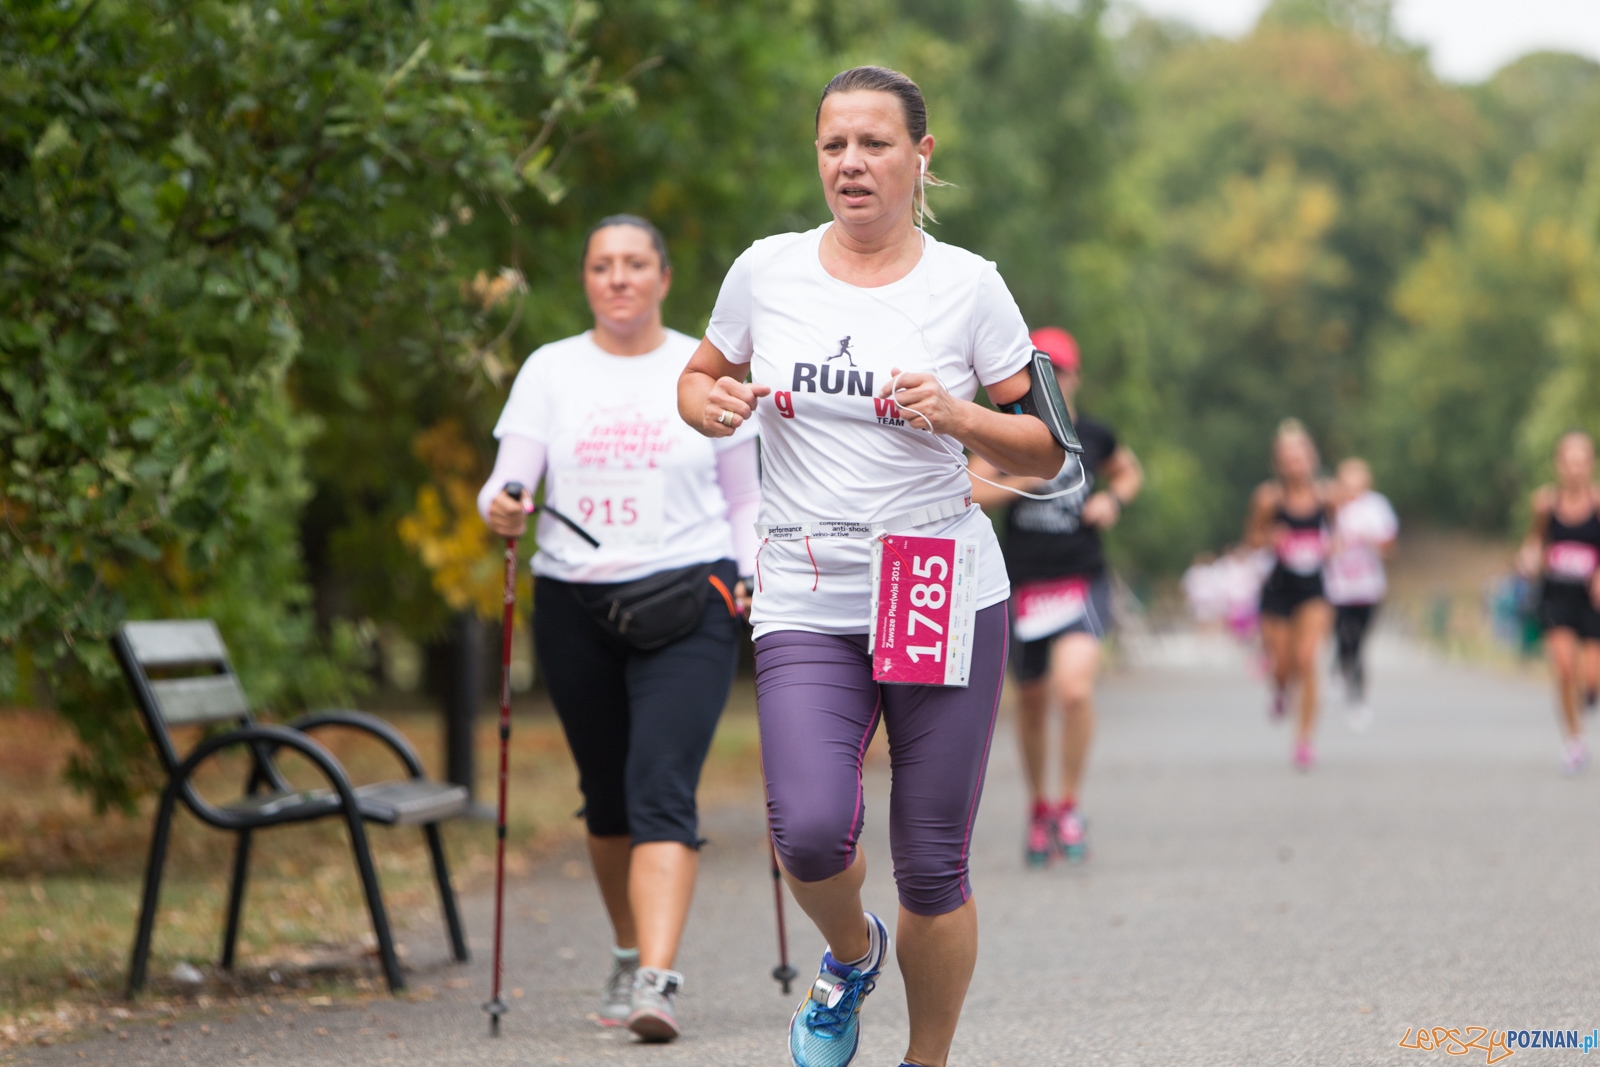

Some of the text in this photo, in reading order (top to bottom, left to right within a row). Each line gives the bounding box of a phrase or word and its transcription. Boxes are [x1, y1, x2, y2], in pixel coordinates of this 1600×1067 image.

[792, 362, 874, 397] RUN
[774, 390, 795, 419] g
[877, 416, 905, 427] TEAM
[577, 496, 639, 526] 915
[768, 525, 802, 534] performance
[891, 560, 901, 582] 2016
[888, 584, 899, 618] Pier(w)si
[906, 555, 948, 663] 1785
[886, 618, 896, 649] Zawsze
